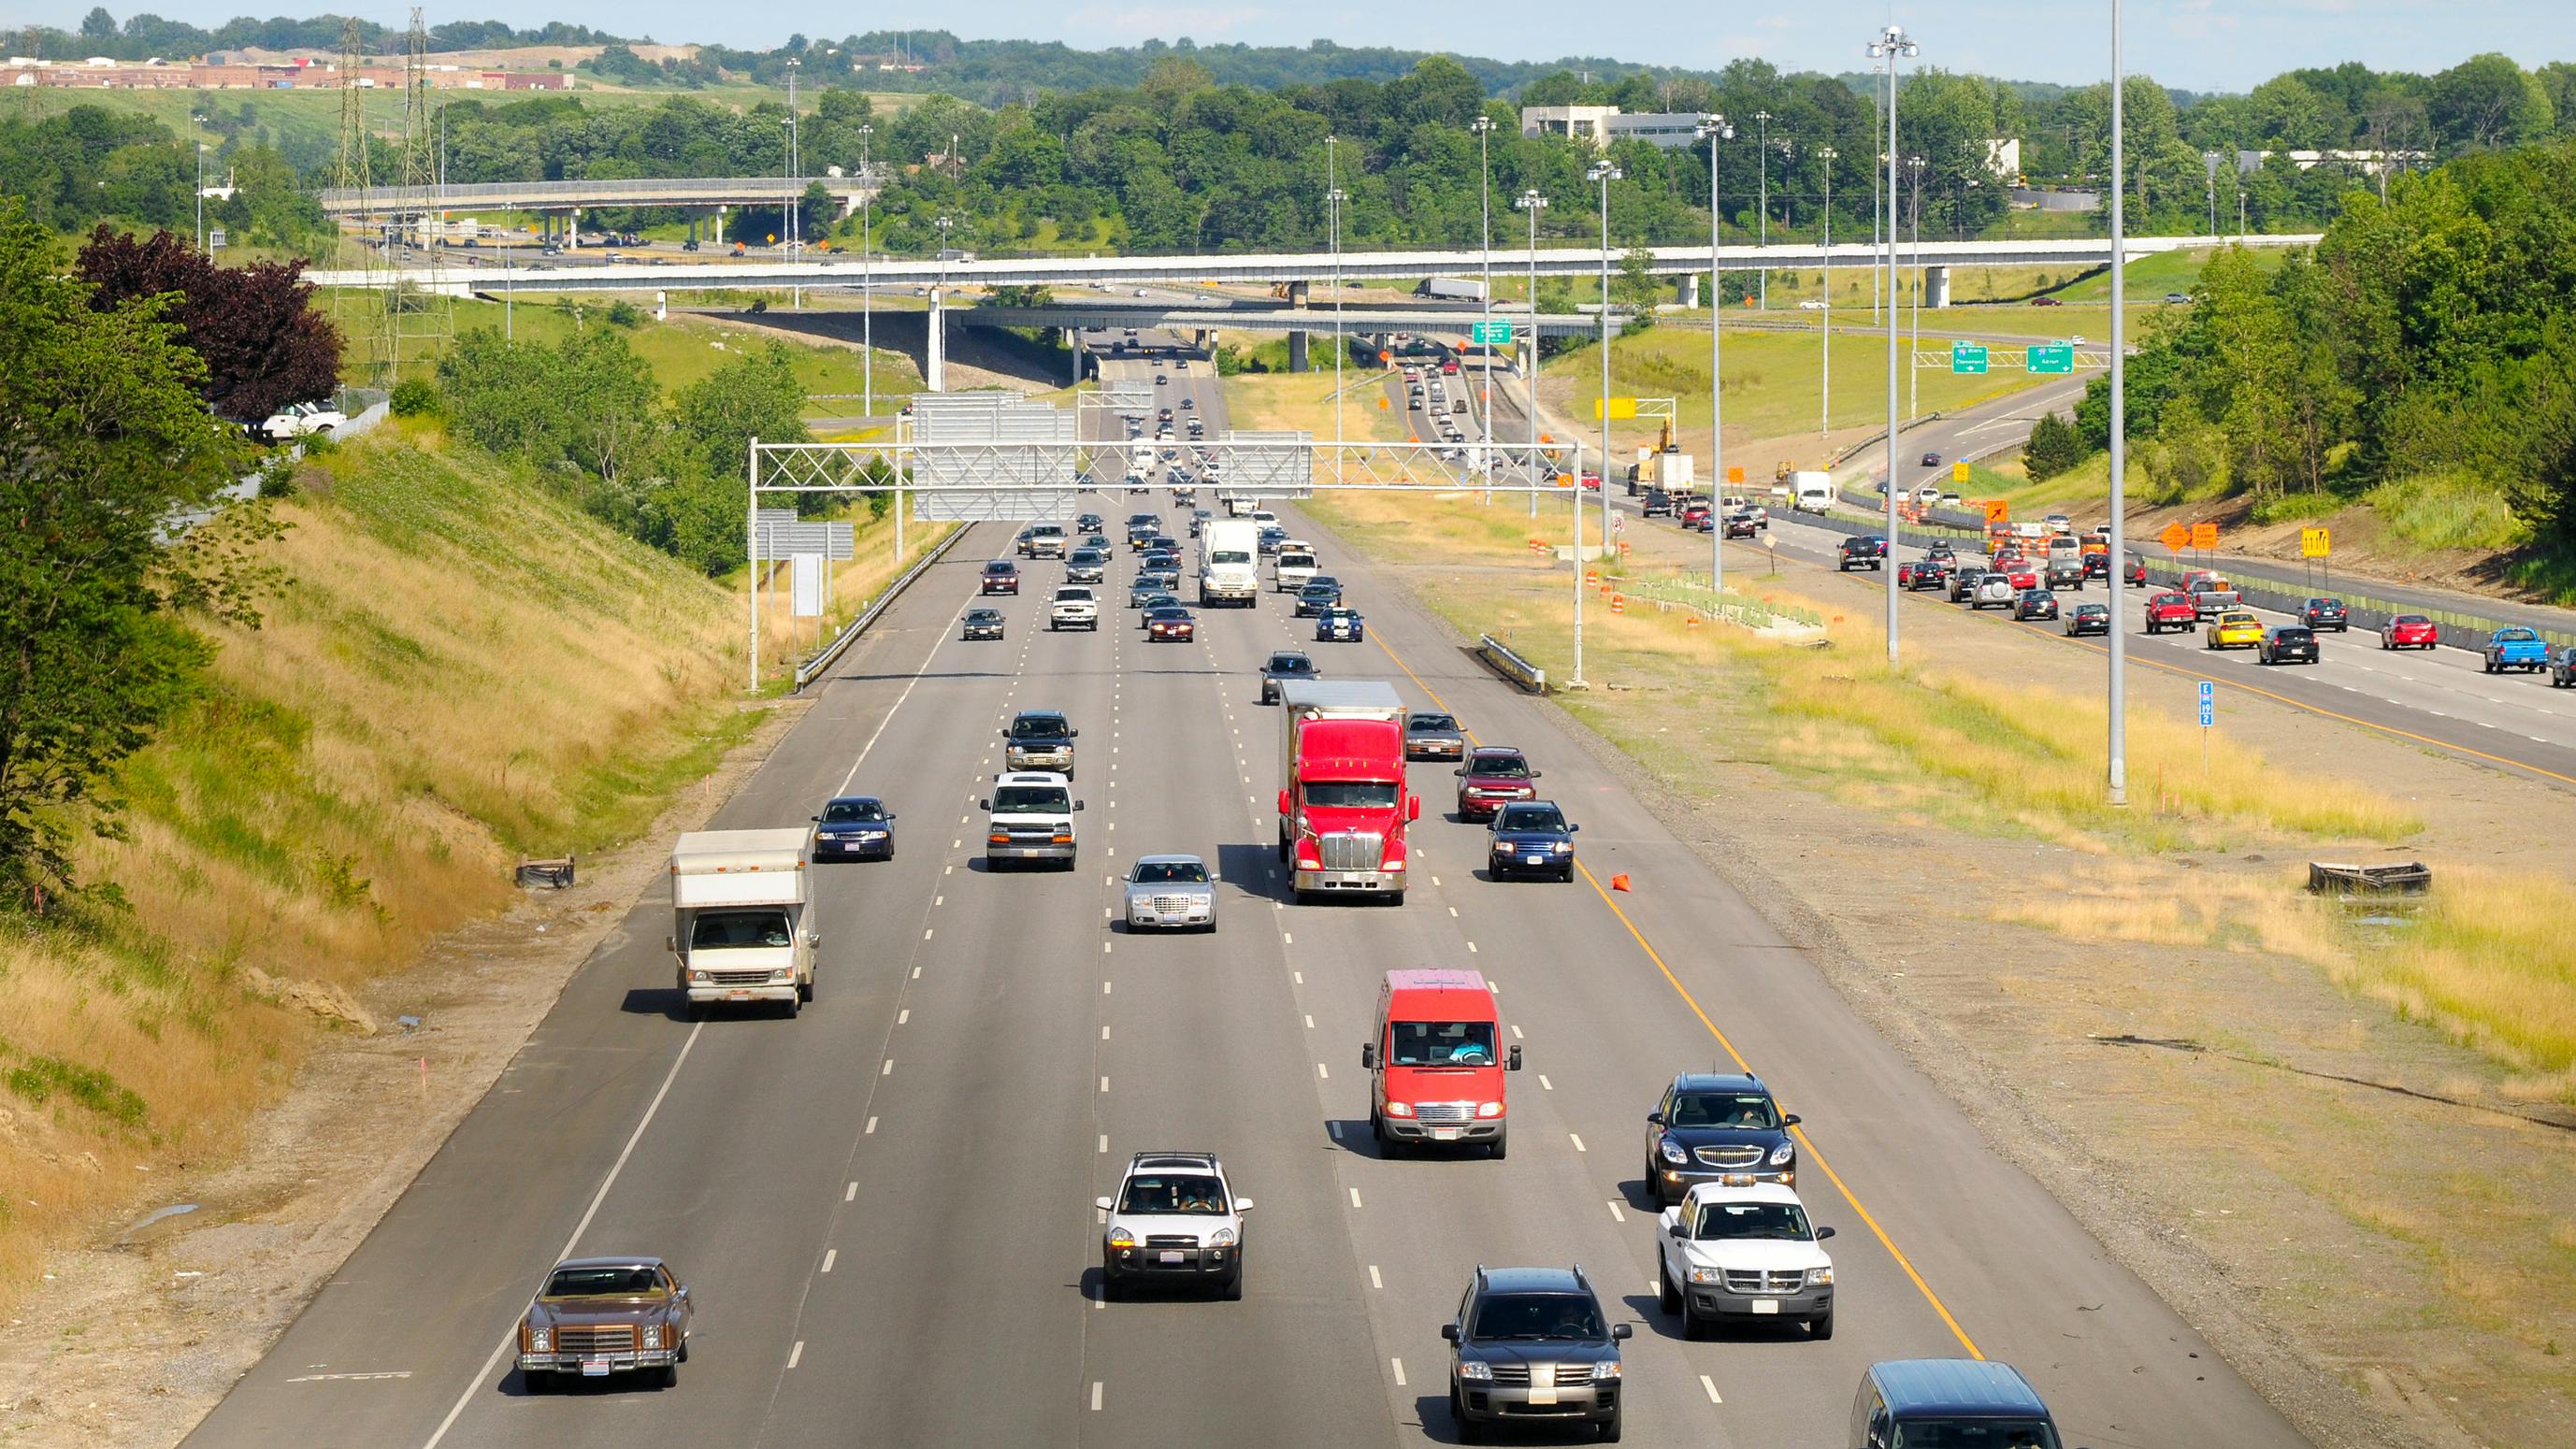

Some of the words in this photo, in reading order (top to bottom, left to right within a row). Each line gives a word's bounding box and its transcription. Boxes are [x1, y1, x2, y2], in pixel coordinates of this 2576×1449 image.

[2203, 684, 2209, 694] E
[2202, 704, 2210, 713] 19
[2203, 715, 2209, 724] 2
